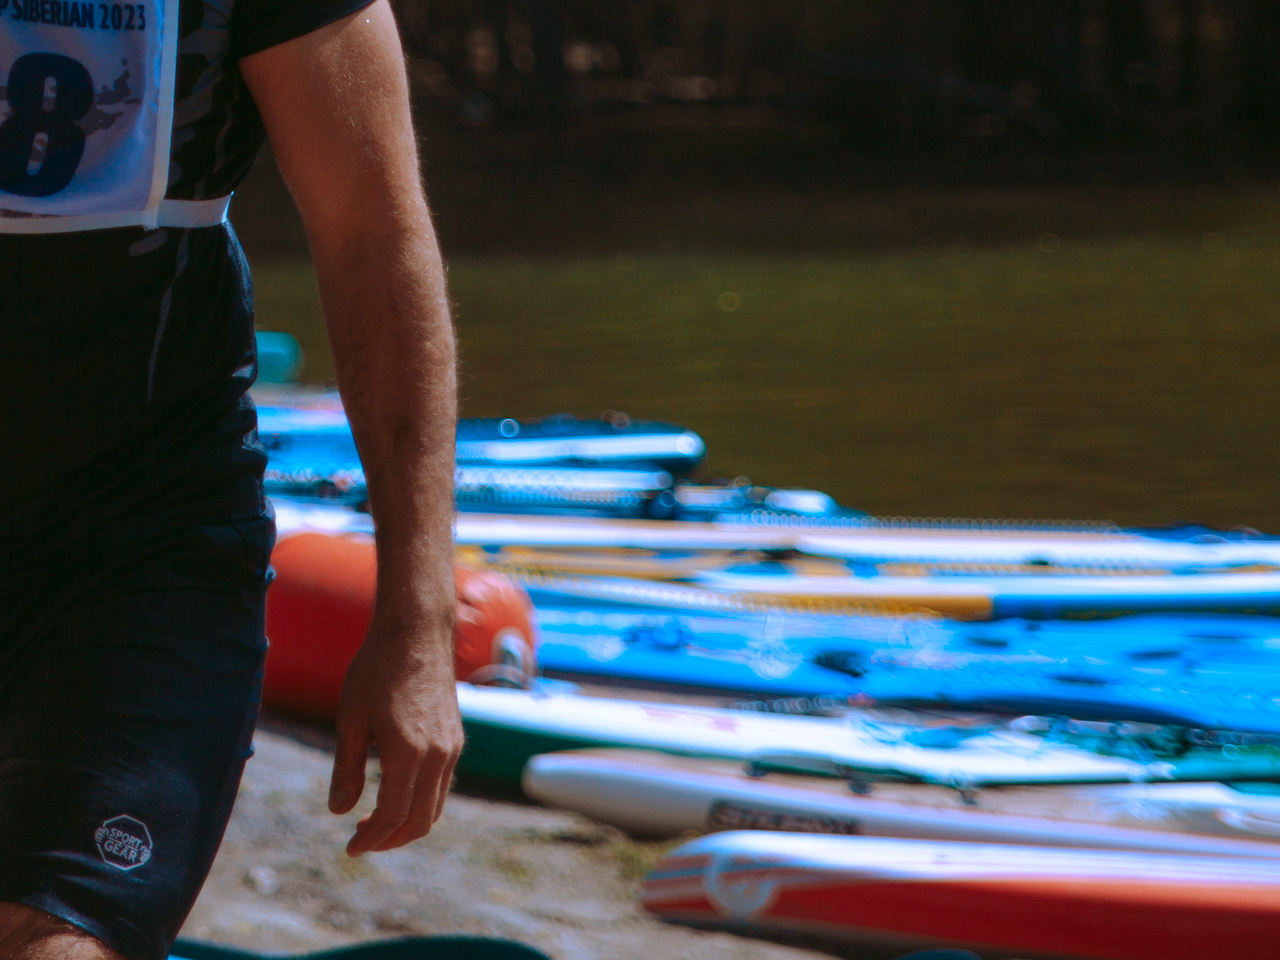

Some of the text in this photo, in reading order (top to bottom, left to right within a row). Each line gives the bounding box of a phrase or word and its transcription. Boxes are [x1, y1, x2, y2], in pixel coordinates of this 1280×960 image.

[98, 3, 146, 31] 2023
[109, 827, 143, 849] SPORT
[104, 840, 138, 863] GEAR
